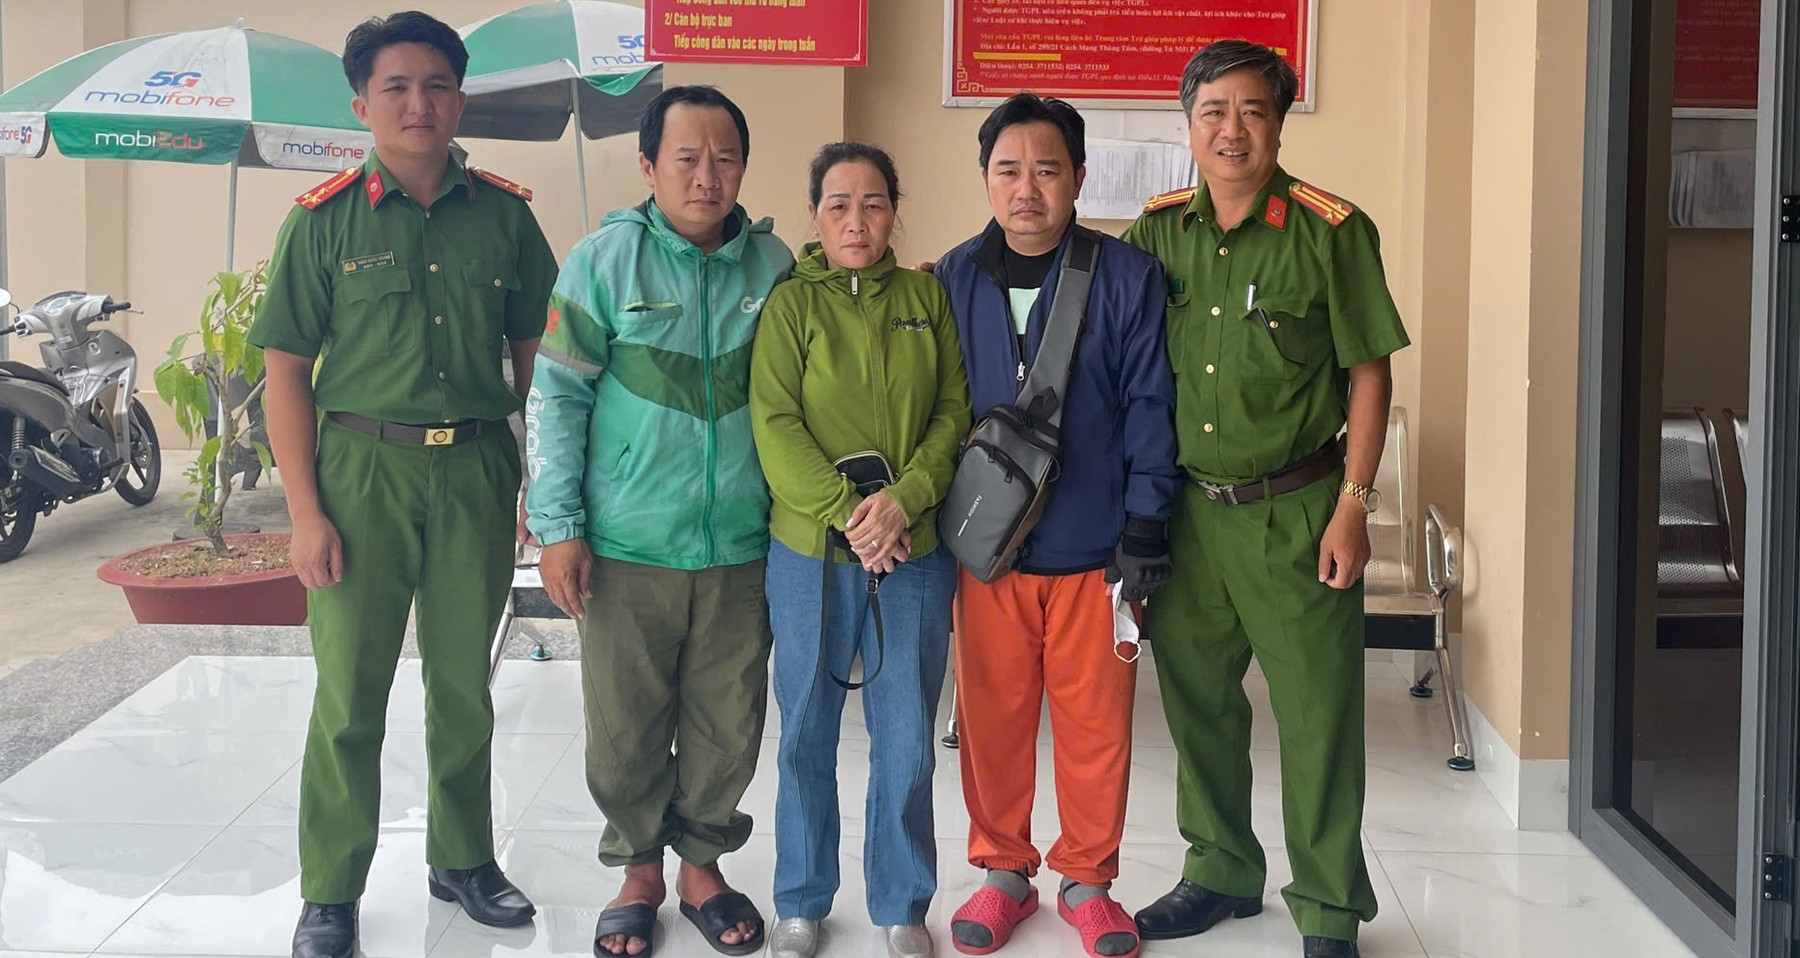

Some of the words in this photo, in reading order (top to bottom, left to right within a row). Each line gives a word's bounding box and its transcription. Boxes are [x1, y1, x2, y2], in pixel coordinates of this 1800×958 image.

[673, 12, 689, 26] Cán
[690, 13, 700, 29] bộ
[701, 13, 717, 29] trực
[718, 13, 732, 27] ban
[673, 32, 690, 49] Tiếp
[691, 34, 710, 50] công
[711, 35, 726, 49] dân
[727, 35, 741, 50] vào
[742, 36, 757, 50] các
[758, 36, 776, 52] ngày
[777, 37, 798, 52] trong
[144, 71, 202, 88] 5G
[84, 89, 236, 108] mobifone
[20, 125, 32, 144] 5G
[282, 140, 364, 160] mobifone
